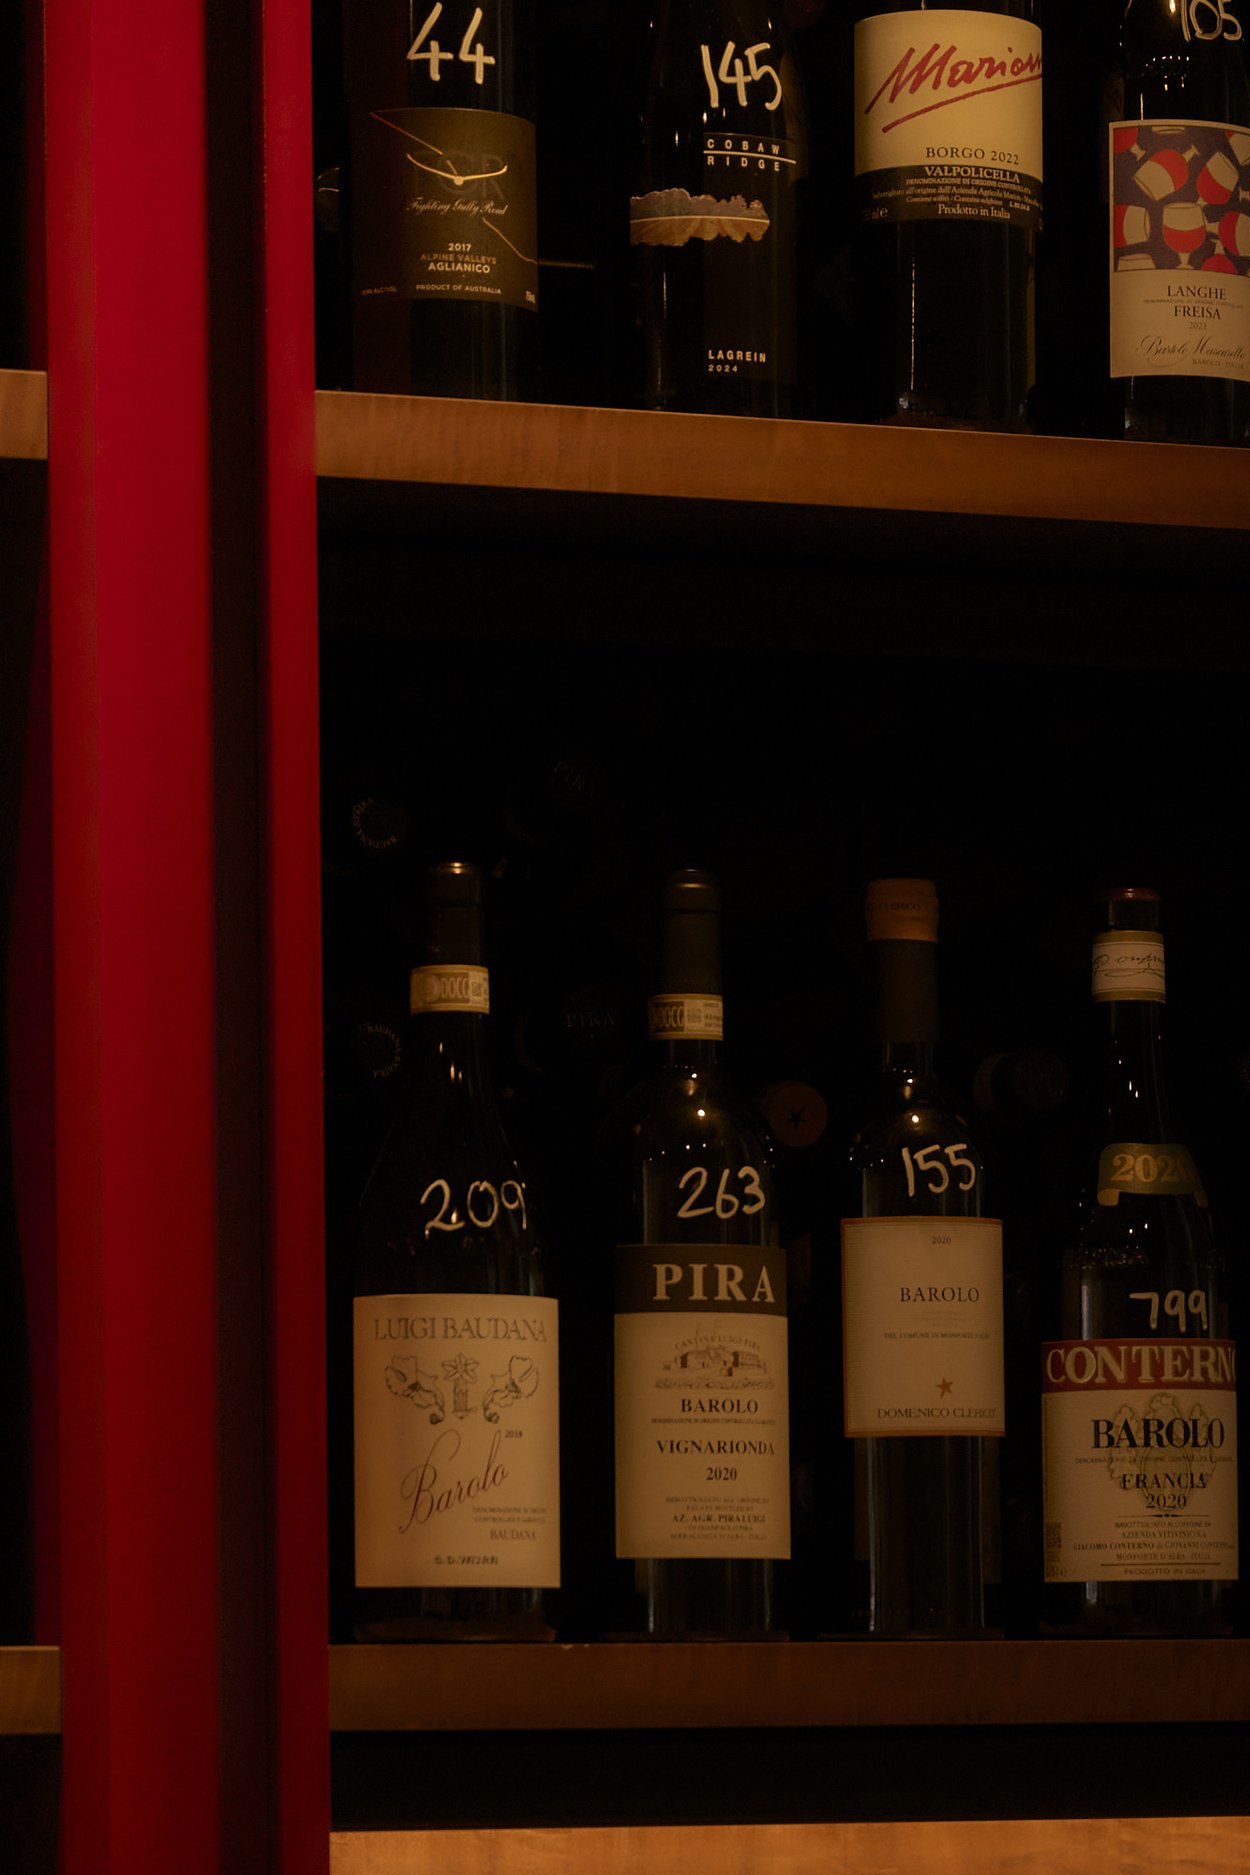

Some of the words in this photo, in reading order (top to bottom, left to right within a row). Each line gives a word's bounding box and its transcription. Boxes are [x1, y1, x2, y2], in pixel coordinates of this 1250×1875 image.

[406, 1, 496, 85] 44
[701, 41, 782, 111] 145
[707, 138, 780, 155] COBAW
[707, 155, 780, 172] RIDGE
[926, 147, 985, 160] BORGO
[991, 150, 1019, 165] 2022
[925, 166, 1020, 184] VALPOLICELLA
[938, 203, 979, 215] Prodotto
[980, 205, 989, 215] in
[448, 243, 471, 252] 2017
[428, 262, 490, 274] AGLIANICO
[1167, 285, 1227, 301] LANGHE
[1174, 305, 1221, 320] FREISA
[708, 350, 766, 364] LAGREIN
[902, 1143, 976, 1198] 155
[677, 1165, 766, 1219] 263
[421, 1178, 528, 1232] 209
[653, 1263, 776, 1304] PIRA
[900, 1286, 980, 1303] BAROLO
[374, 1318, 436, 1341] LUIGI
[442, 1317, 547, 1343] BAUDANA
[681, 1398, 759, 1414] BAROLO
[1091, 1418, 1225, 1449] BAROLO
[657, 1440, 775, 1456] VIGNARIONDA
[398, 1429, 509, 1535] Barolo
[706, 1466, 738, 1481] 2020
[1145, 1494, 1187, 1509] 2020
